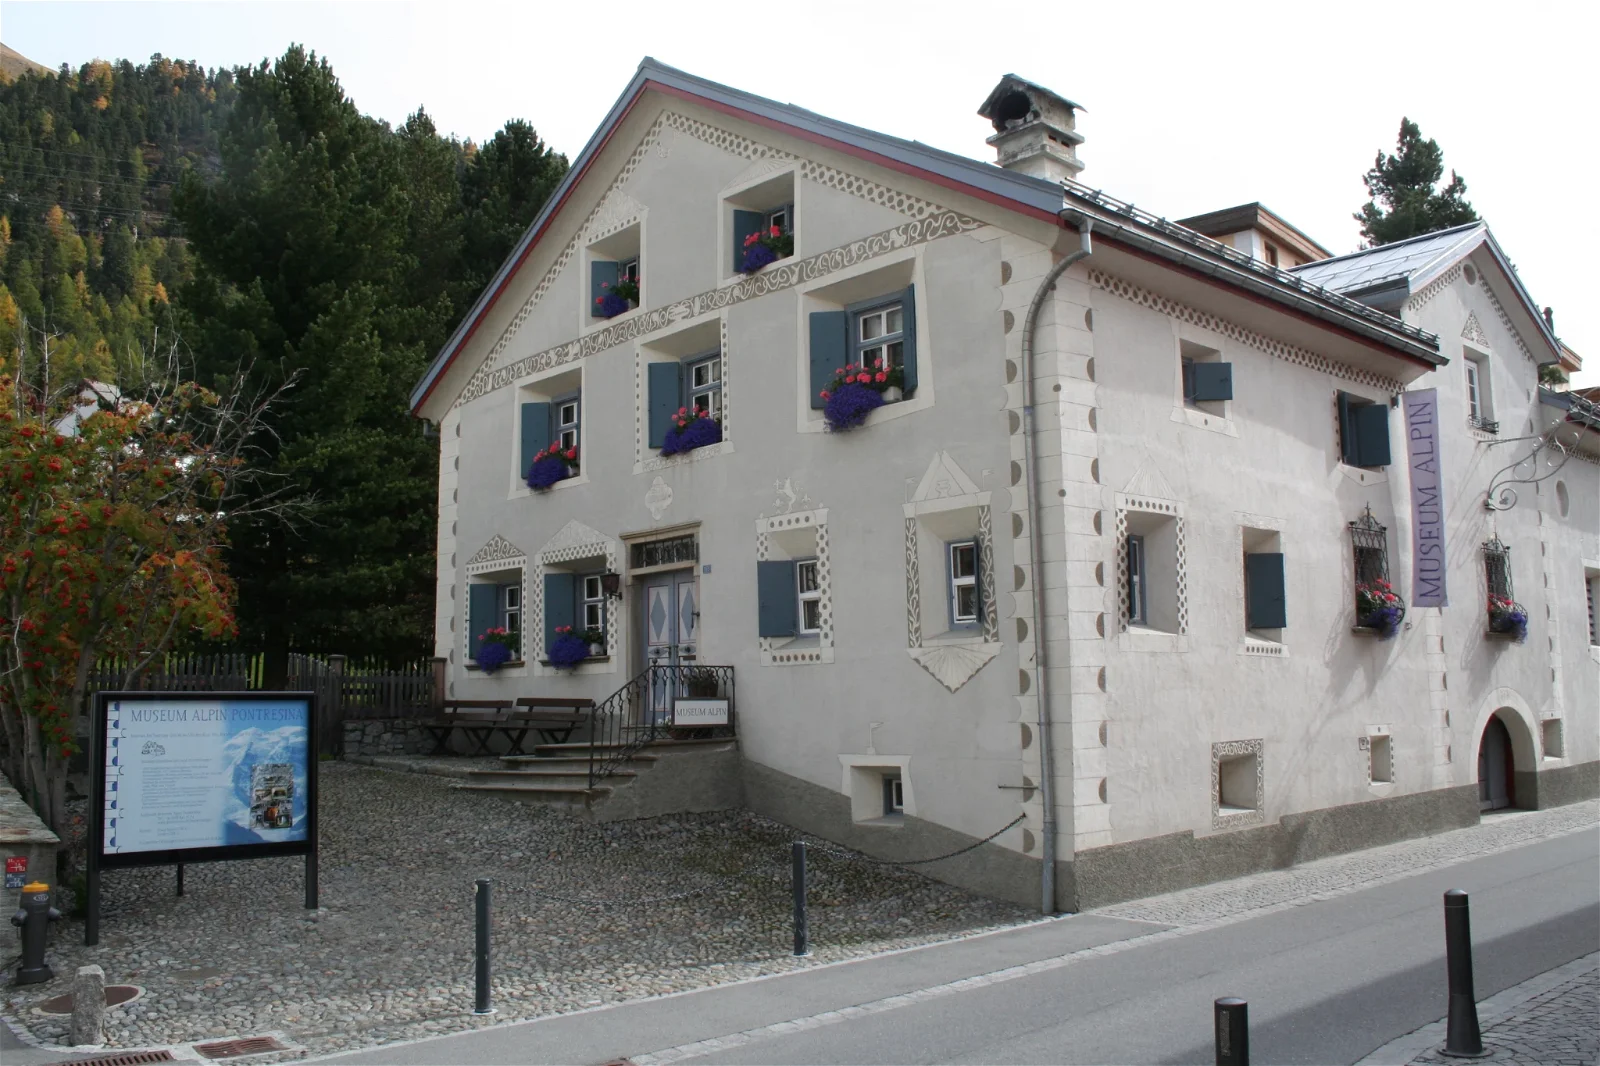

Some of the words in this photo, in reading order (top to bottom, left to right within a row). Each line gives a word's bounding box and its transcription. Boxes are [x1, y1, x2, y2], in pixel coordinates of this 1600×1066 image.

[1408, 401, 1436, 475] ALPIN
[1416, 485, 1442, 598] MUSEUM
[131, 709, 187, 723] MUSEUM
[192, 708, 227, 722] ALPIN
[231, 708, 304, 722] PONTRESINA
[676, 708, 706, 716] MUSEUM
[707, 708, 727, 716] ALPIN
